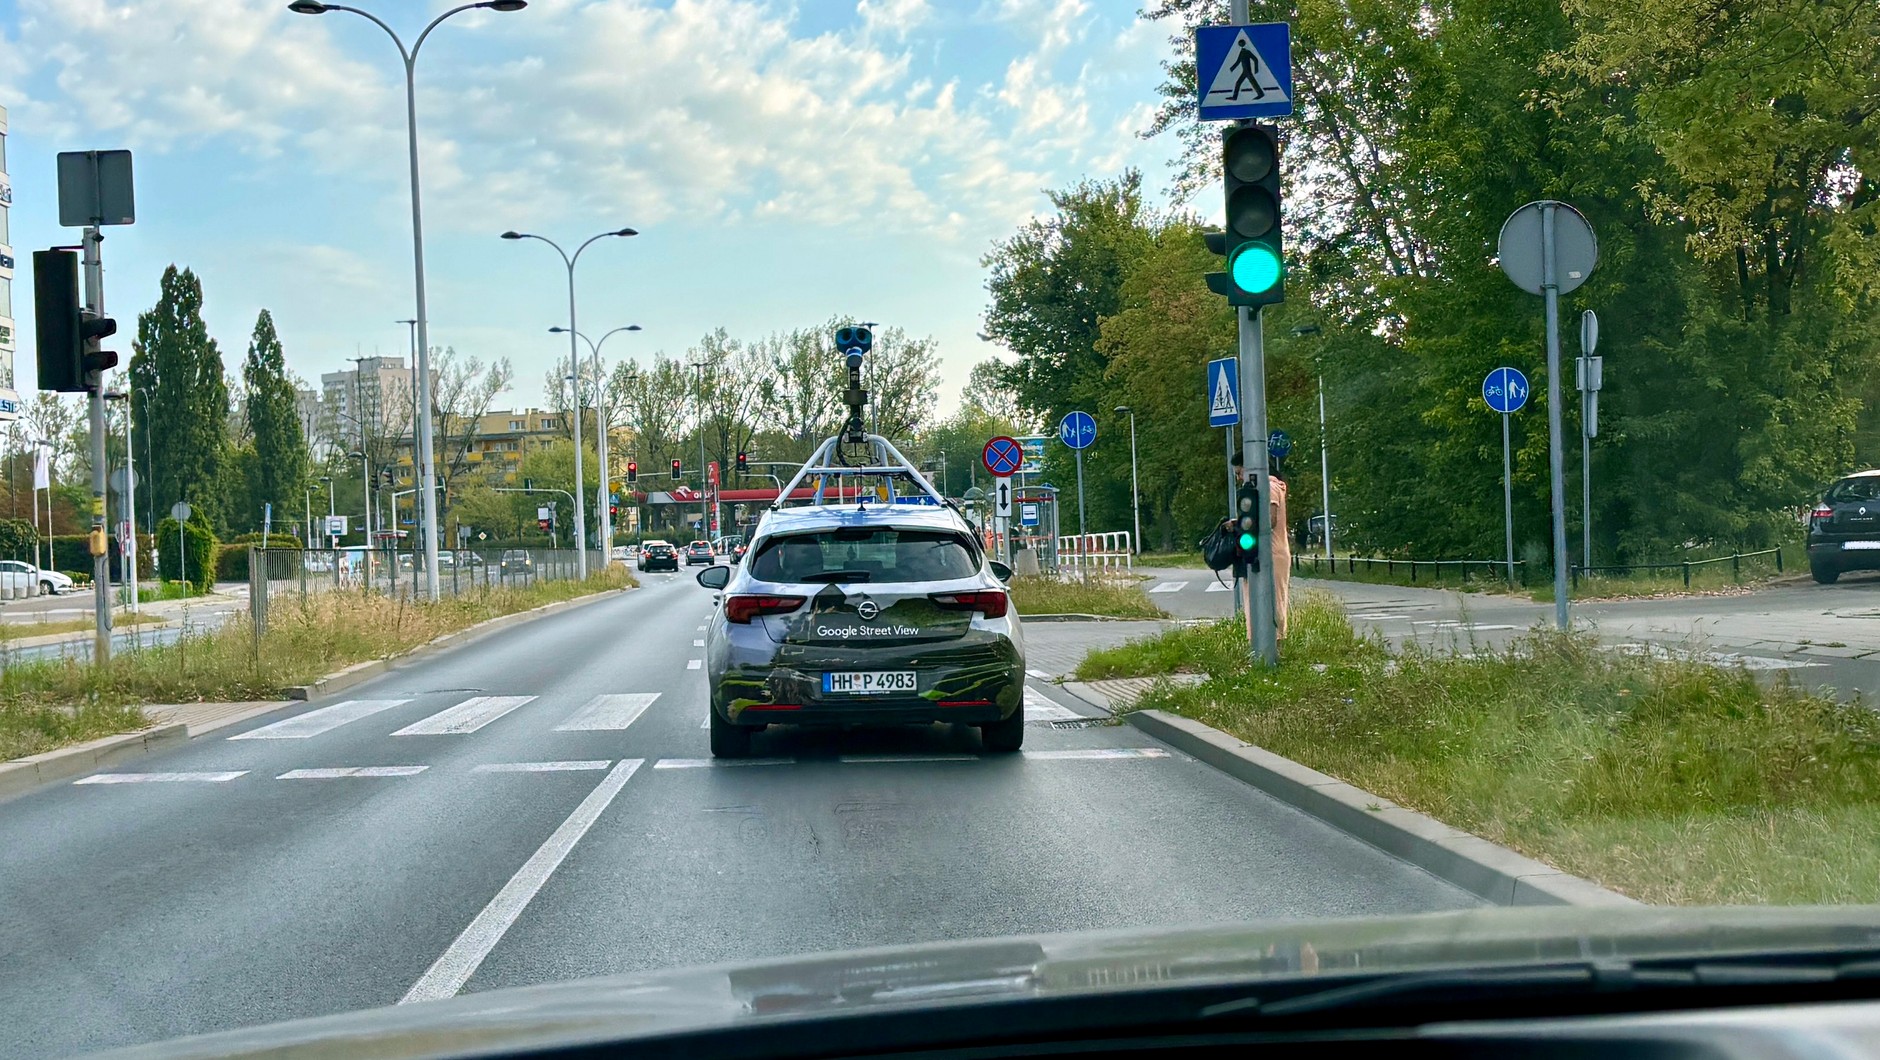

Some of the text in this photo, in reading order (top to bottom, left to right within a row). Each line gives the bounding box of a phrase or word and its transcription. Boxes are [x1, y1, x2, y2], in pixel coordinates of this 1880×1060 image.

[817, 624, 920, 639] Google Street View
[831, 672, 915, 690] HH P 4983
